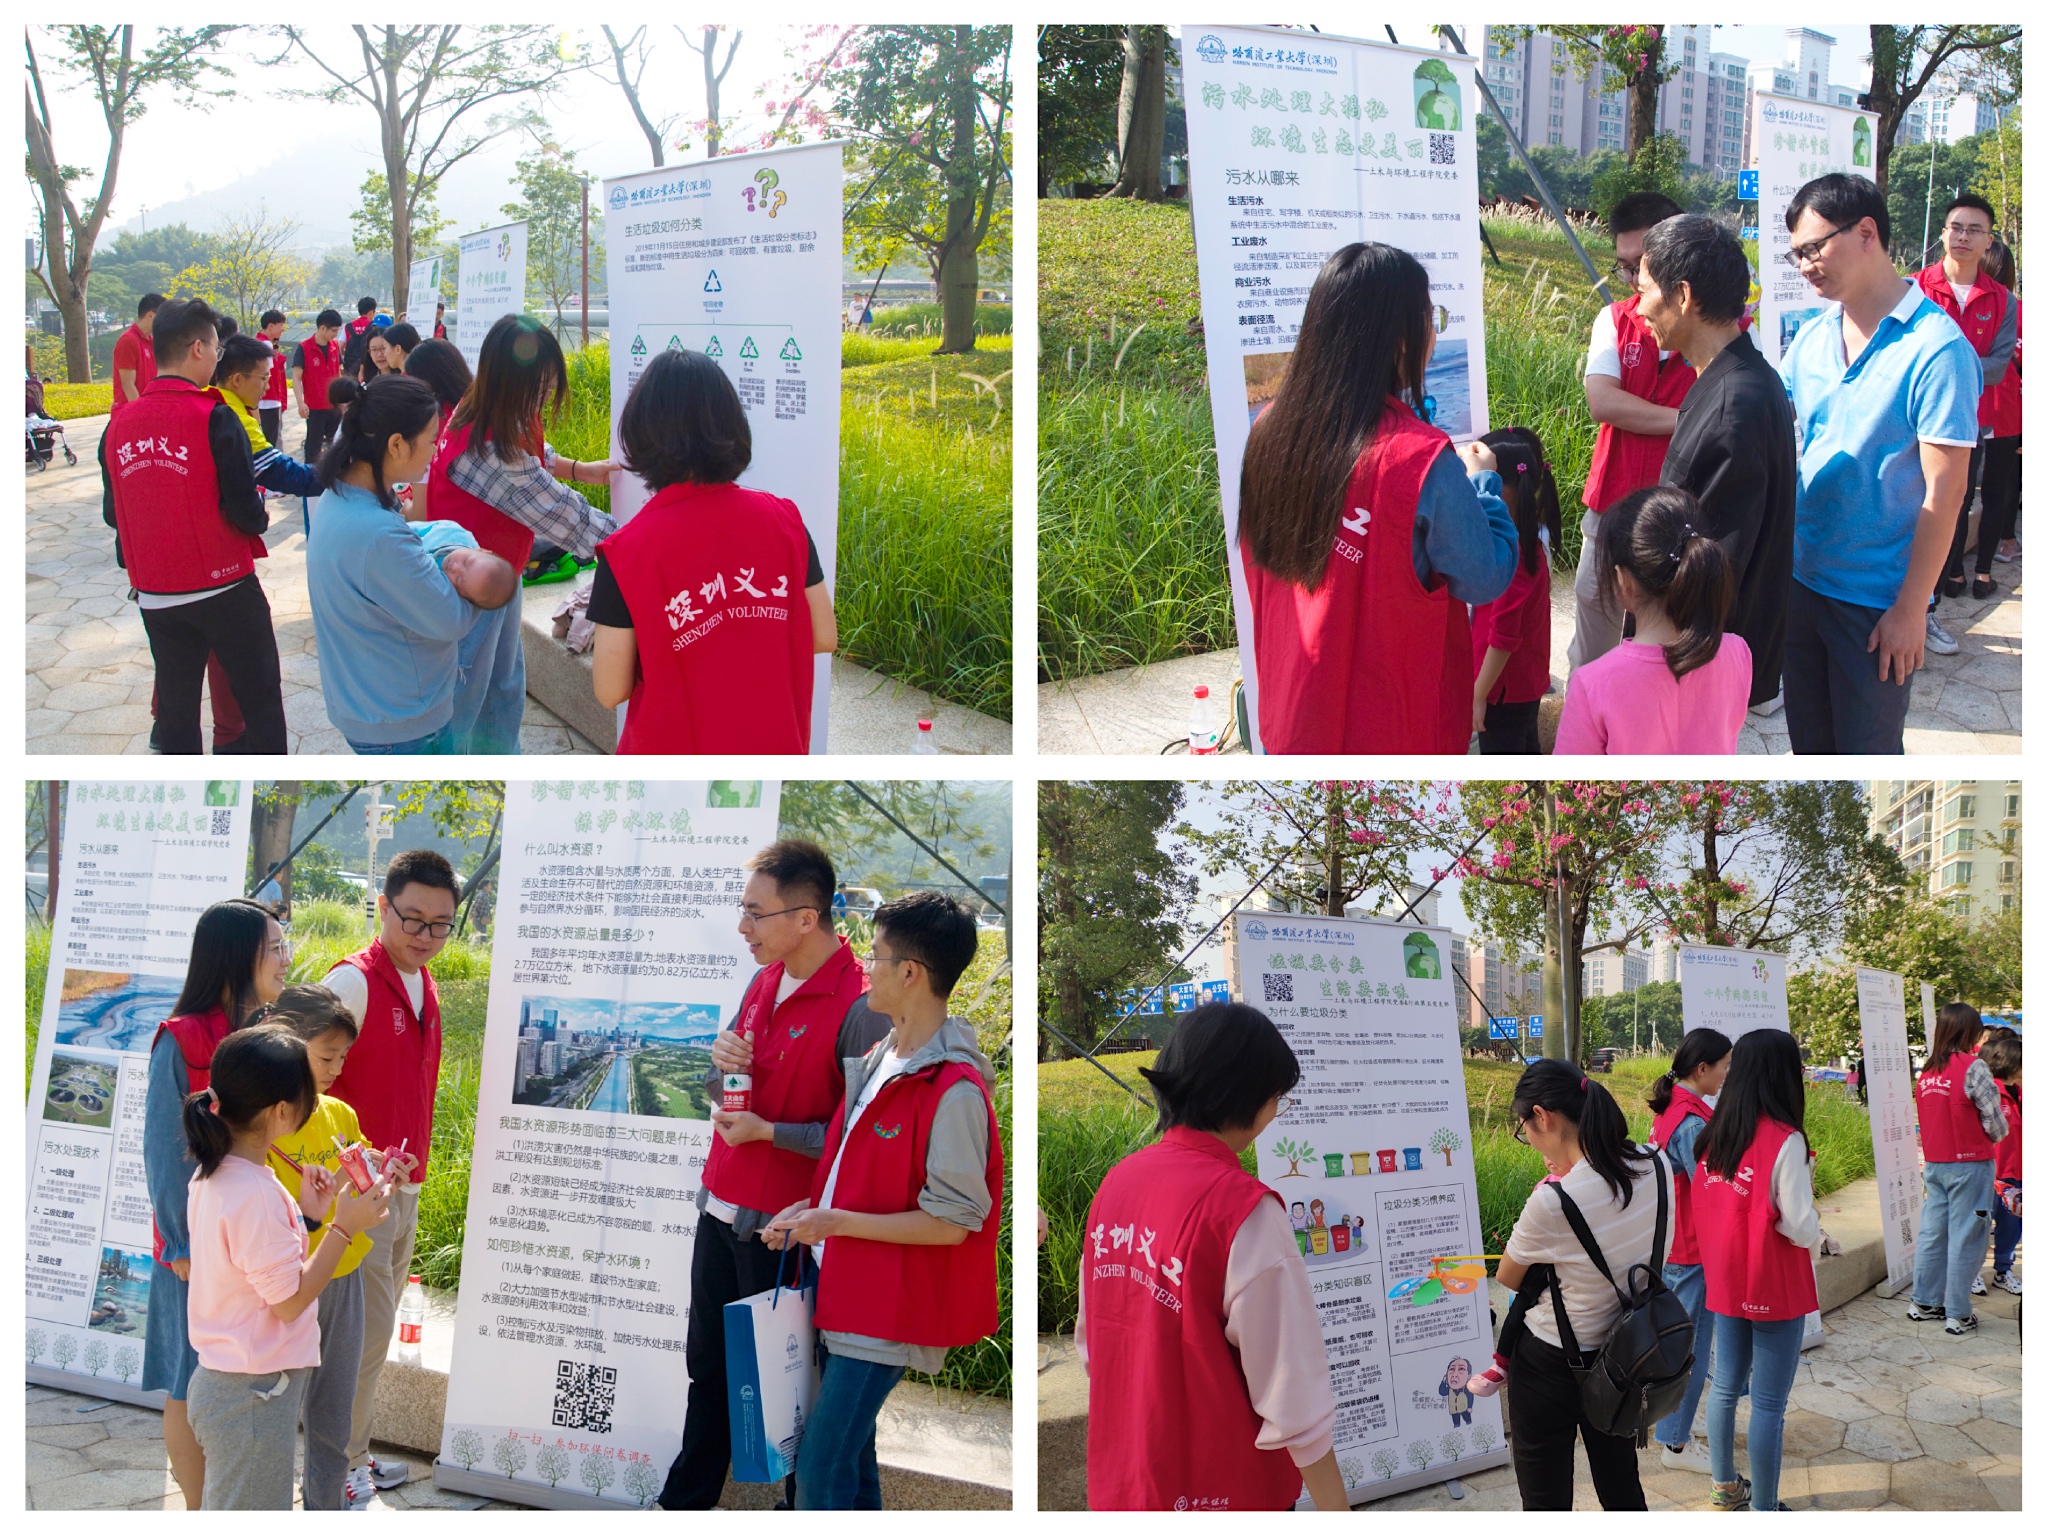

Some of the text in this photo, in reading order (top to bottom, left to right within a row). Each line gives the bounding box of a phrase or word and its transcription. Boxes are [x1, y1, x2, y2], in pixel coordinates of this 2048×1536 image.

[1202, 81, 1389, 122] 污水处理大揭秘
[1250, 124, 1424, 161] 环境生态更美丽
[1226, 169, 1300, 186] 污水从哪来
[1228, 196, 1264, 206] 生活污水
[625, 217, 702, 237] 生活垃圾如何分类
[1231, 236, 1267, 247] 工业废水
[1235, 277, 1271, 288] 商业污水
[1238, 314, 1275, 325] 表面径流
[116, 436, 189, 466] 深圳义工
[120, 459, 189, 479] SHENZHEN VOLUNTEER
[664, 567, 789, 631] 深圳义工
[672, 605, 789, 652] SHENZHEN VOLUNTEER
[76, 784, 186, 804] 污水处理大揭秘
[96, 810, 208, 835] 环境生态更美丽
[574, 808, 692, 835] 保护水环境
[79, 843, 119, 855] 污水从哪来
[525, 843, 603, 857] 什么叫水资源？
[517, 925, 654, 942] 我国的水资源总量是多少？
[1267, 952, 1365, 975] 垃圾要分类
[512, 972, 572, 986] 居世界第六位。
[1212, 983, 1228, 993] 公交车
[1319, 979, 1410, 1000] 生活要品味
[1268, 1006, 1348, 1019] 为什么要垃圾分类
[43, 1141, 100, 1160] 污水处理技术
[1384, 1193, 1456, 1210] 垃圾分类习惯养成
